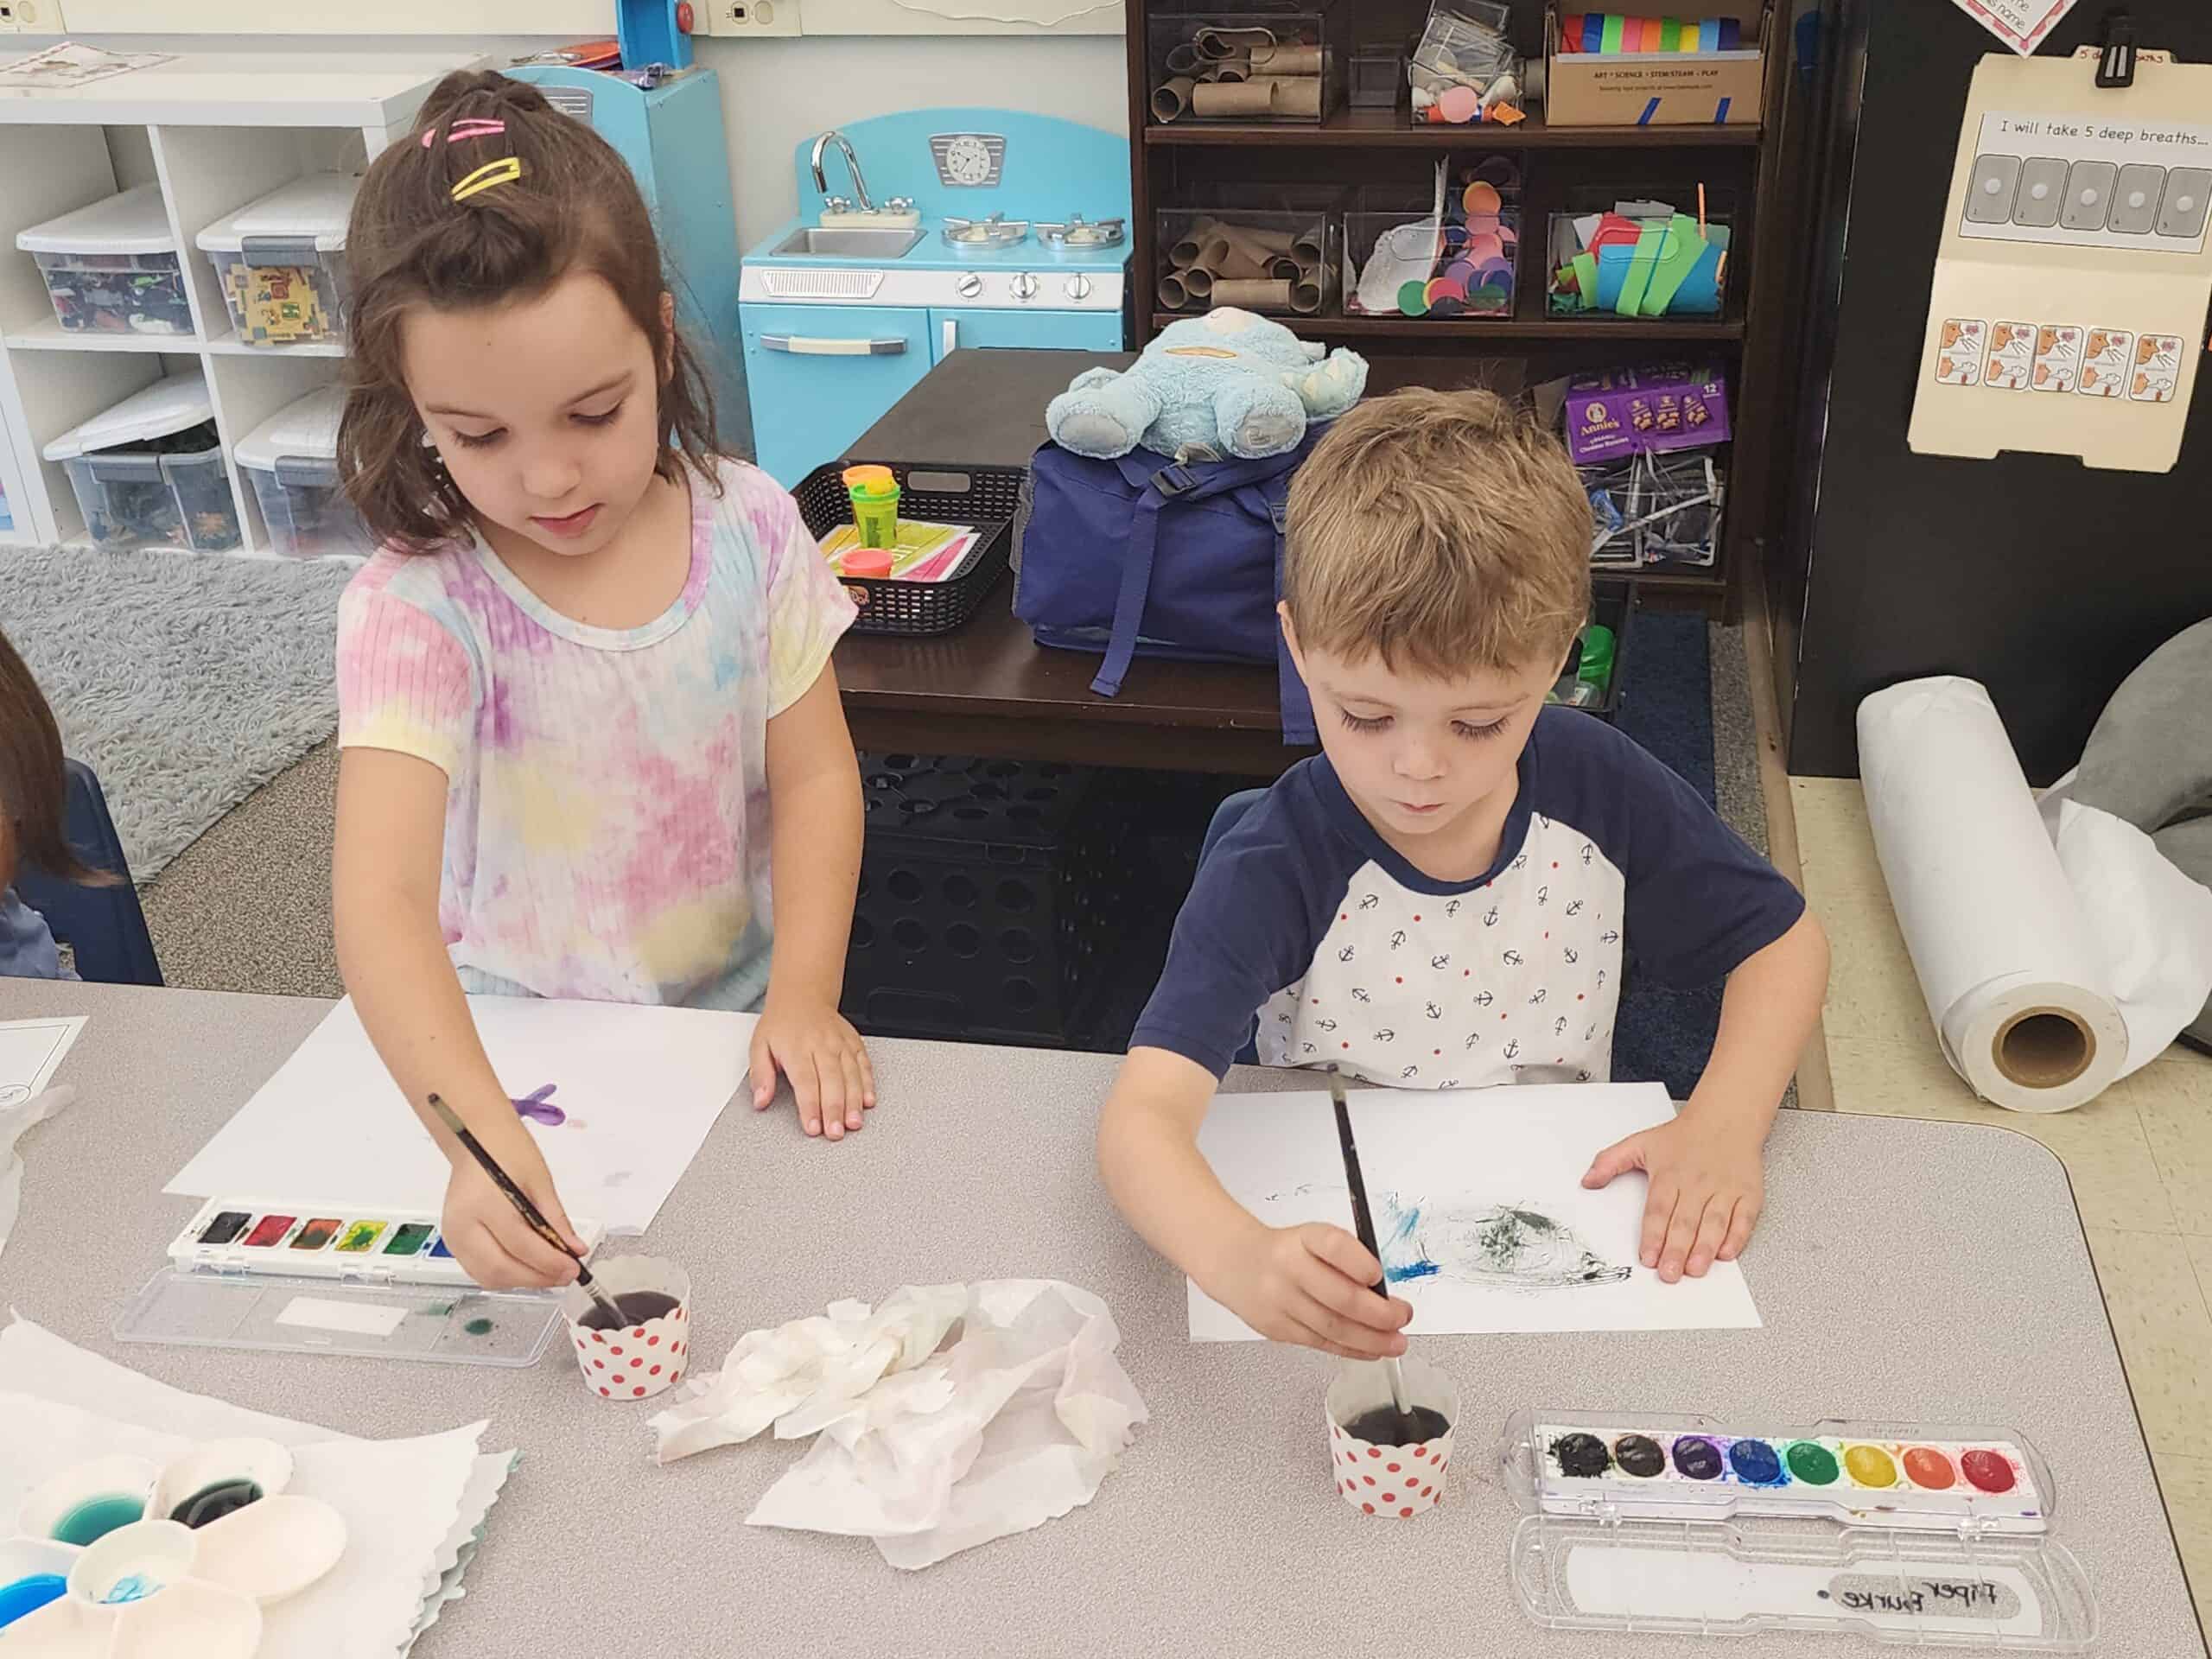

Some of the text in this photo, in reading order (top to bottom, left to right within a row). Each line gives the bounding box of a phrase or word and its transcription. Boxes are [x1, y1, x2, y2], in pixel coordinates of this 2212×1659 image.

[1996, 3, 2026, 29] name
[1615, 70, 1643, 79] SCIENCE
[2001, 119, 2010, 132] I
[2014, 120, 2039, 135] will
[2046, 122, 2079, 137] take
[2084, 124, 2094, 138] 5
[2098, 126, 2134, 144] deep
[1703, 383, 1718, 394] 12
[1580, 417, 1621, 435] Annie's
